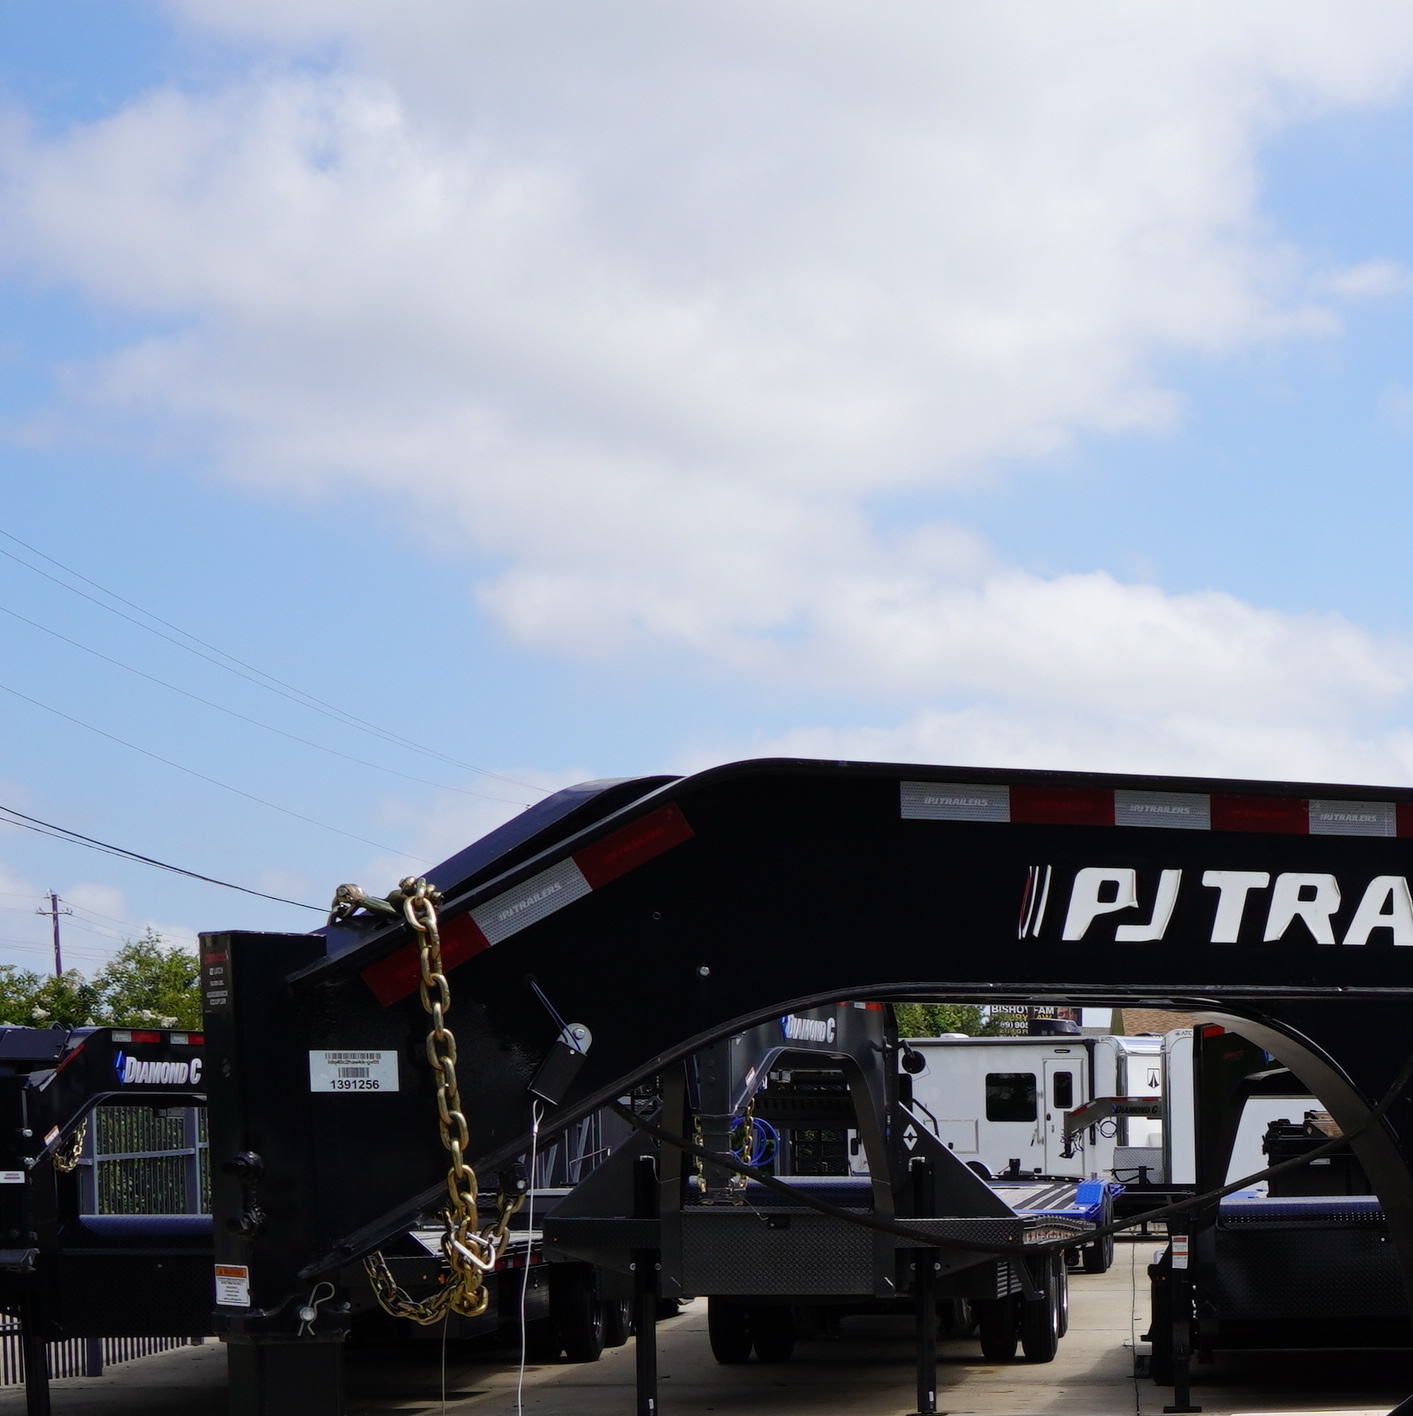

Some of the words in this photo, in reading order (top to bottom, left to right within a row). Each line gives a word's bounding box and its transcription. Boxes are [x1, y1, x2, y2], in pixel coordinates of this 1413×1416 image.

[1062, 867, 1183, 942] PJ
[786, 1013, 827, 1042] DIAMOND
[827, 1017, 836, 1044] C
[124, 1056, 189, 1084] DIAMOND
[190, 1057, 203, 1085] C
[330, 1079, 380, 1090] 1391256
[1115, 1104, 1151, 1114] DIAMOND
[1151, 1104, 1159, 1115] C
